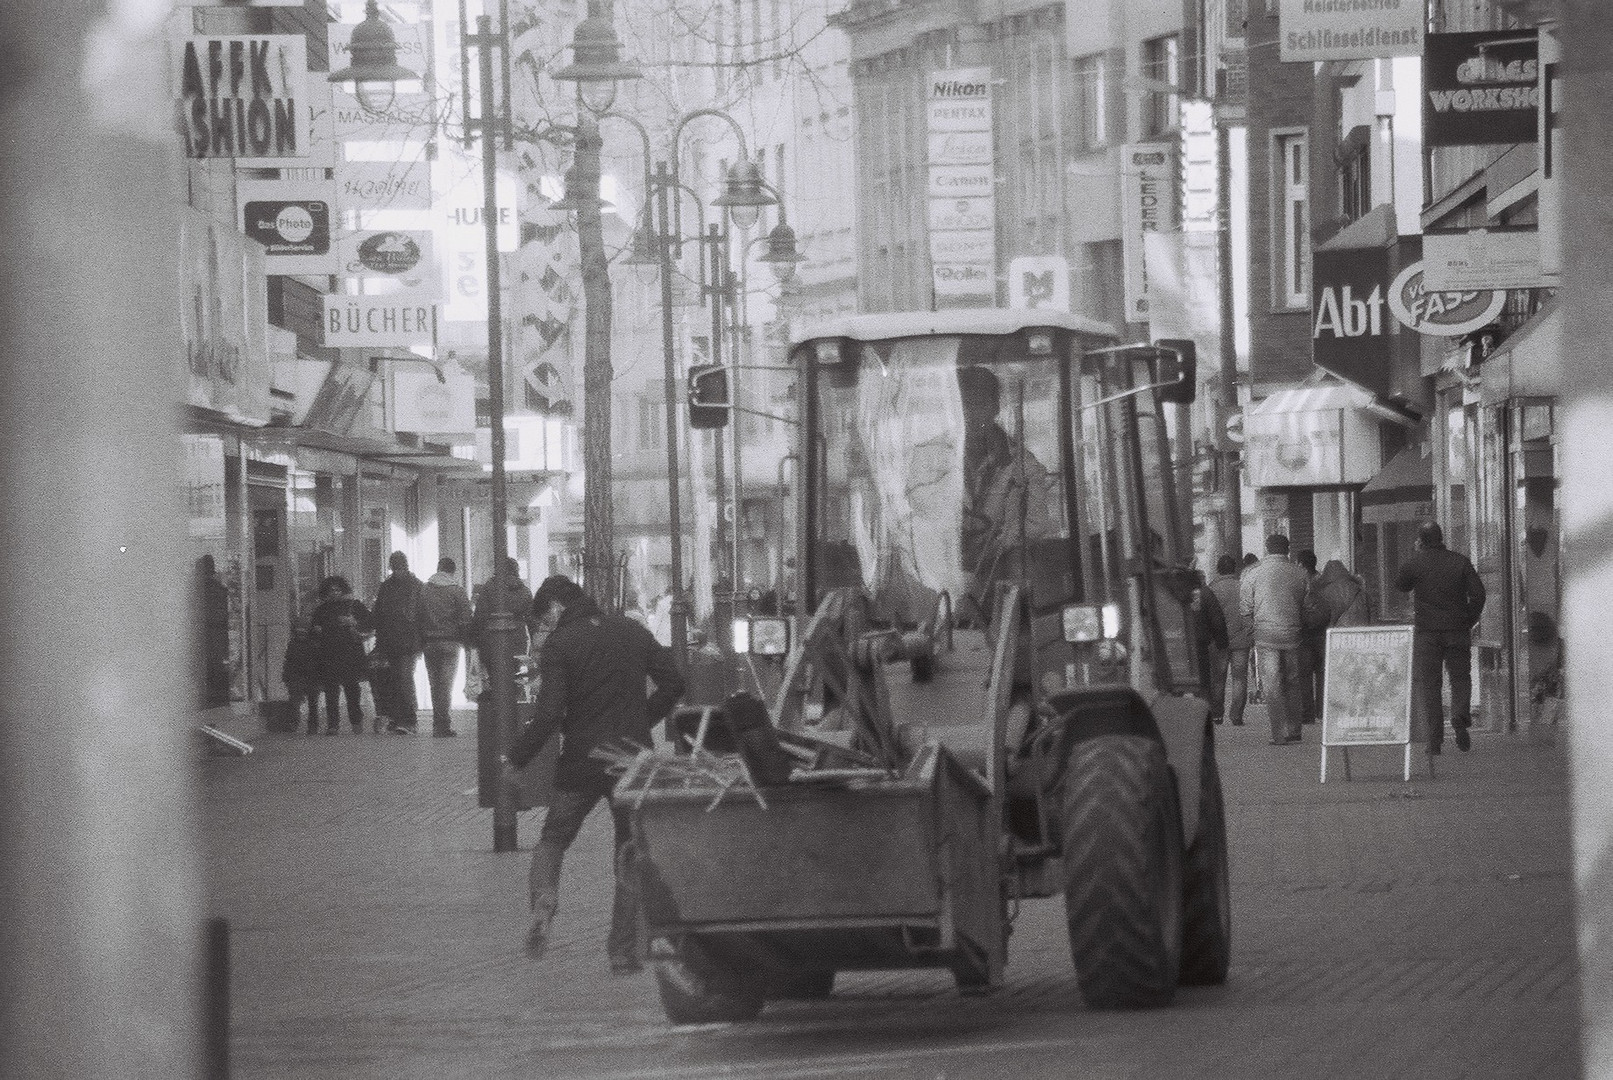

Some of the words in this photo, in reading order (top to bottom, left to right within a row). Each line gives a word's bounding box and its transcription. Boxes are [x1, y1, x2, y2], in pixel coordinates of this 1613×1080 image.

[1287, 26, 1418, 51] Schlüsseldienst
[933, 81, 986, 97] Nikon
[1429, 87, 1538, 112] WORKSHO
[338, 110, 421, 125] MASSAGE
[933, 107, 986, 119] PENTAX
[935, 175, 989, 186] Canon
[279, 218, 311, 230] Photo
[329, 302, 430, 334] BÜCHER
[1313, 283, 1385, 339] Abt
